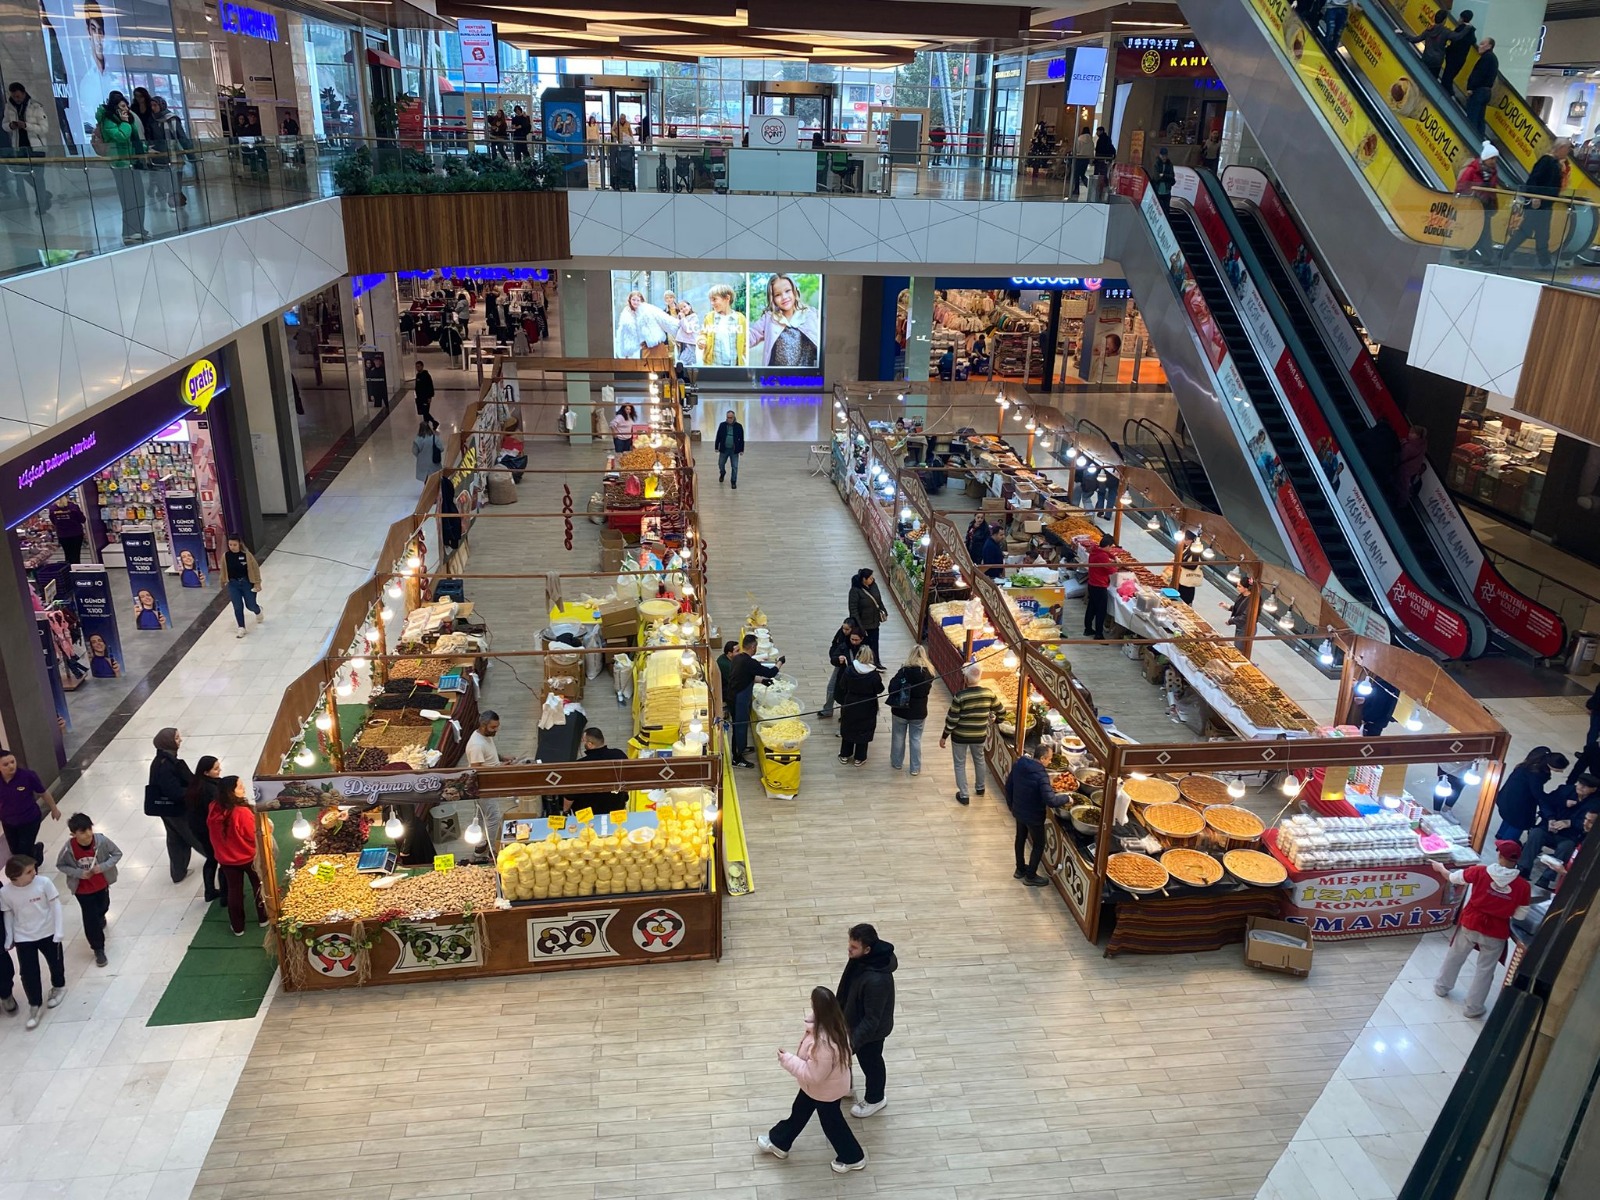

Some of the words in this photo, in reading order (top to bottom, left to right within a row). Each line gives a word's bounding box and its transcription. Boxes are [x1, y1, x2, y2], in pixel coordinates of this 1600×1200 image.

[1072, 73, 1102, 82] SELECTED
[1498, 94, 1541, 149] DÜRÜMLE
[1419, 107, 1459, 163] DÜRÜMLE
[1430, 202, 1457, 222] DURMA
[189, 363, 214, 401] gratis
[1363, 530, 1388, 570] ALANIM
[1447, 530, 1474, 569] ALANIM
[1407, 589, 1435, 613] MEKTEBİM
[1410, 600, 1429, 618] KOLEJİ
[344, 778, 412, 804] Doğanın
[414, 776, 442, 792] Eli
[1319, 872, 1408, 886] MEŞHUR
[1301, 882, 1421, 901] İZMİT
[1314, 899, 1402, 911] KONAK
